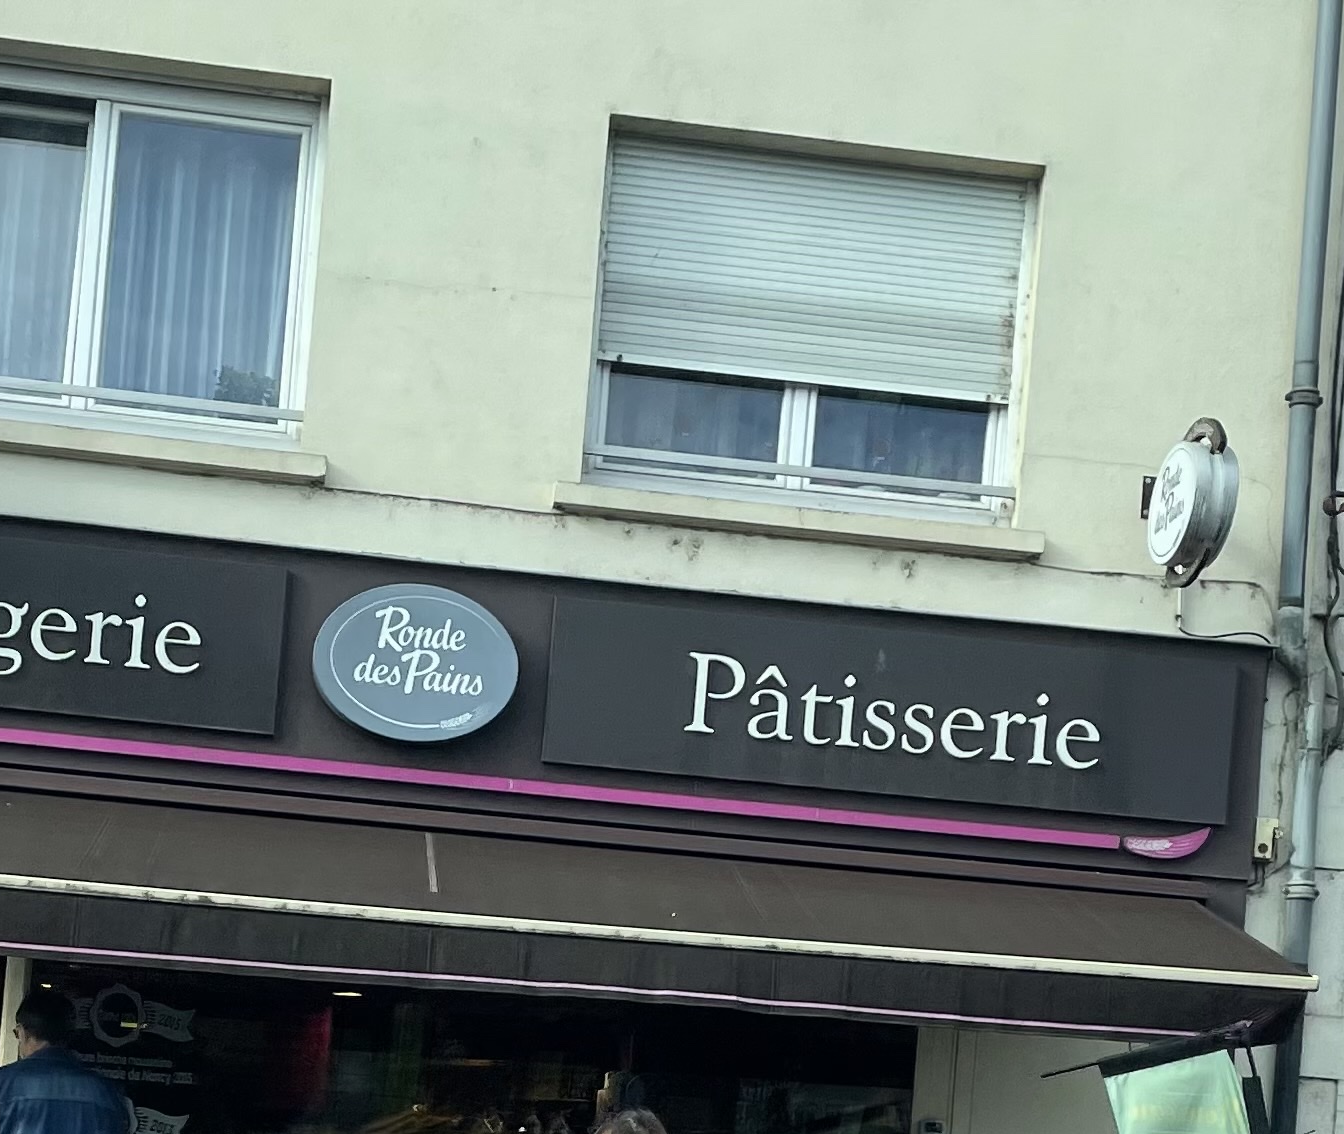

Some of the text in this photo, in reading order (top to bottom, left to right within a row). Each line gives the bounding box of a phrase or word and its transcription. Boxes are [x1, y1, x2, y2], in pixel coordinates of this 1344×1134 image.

[375, 605, 467, 653] Ronde
[353, 649, 484, 696] des Pains
[683, 651, 1101, 770] Pâtisserie
